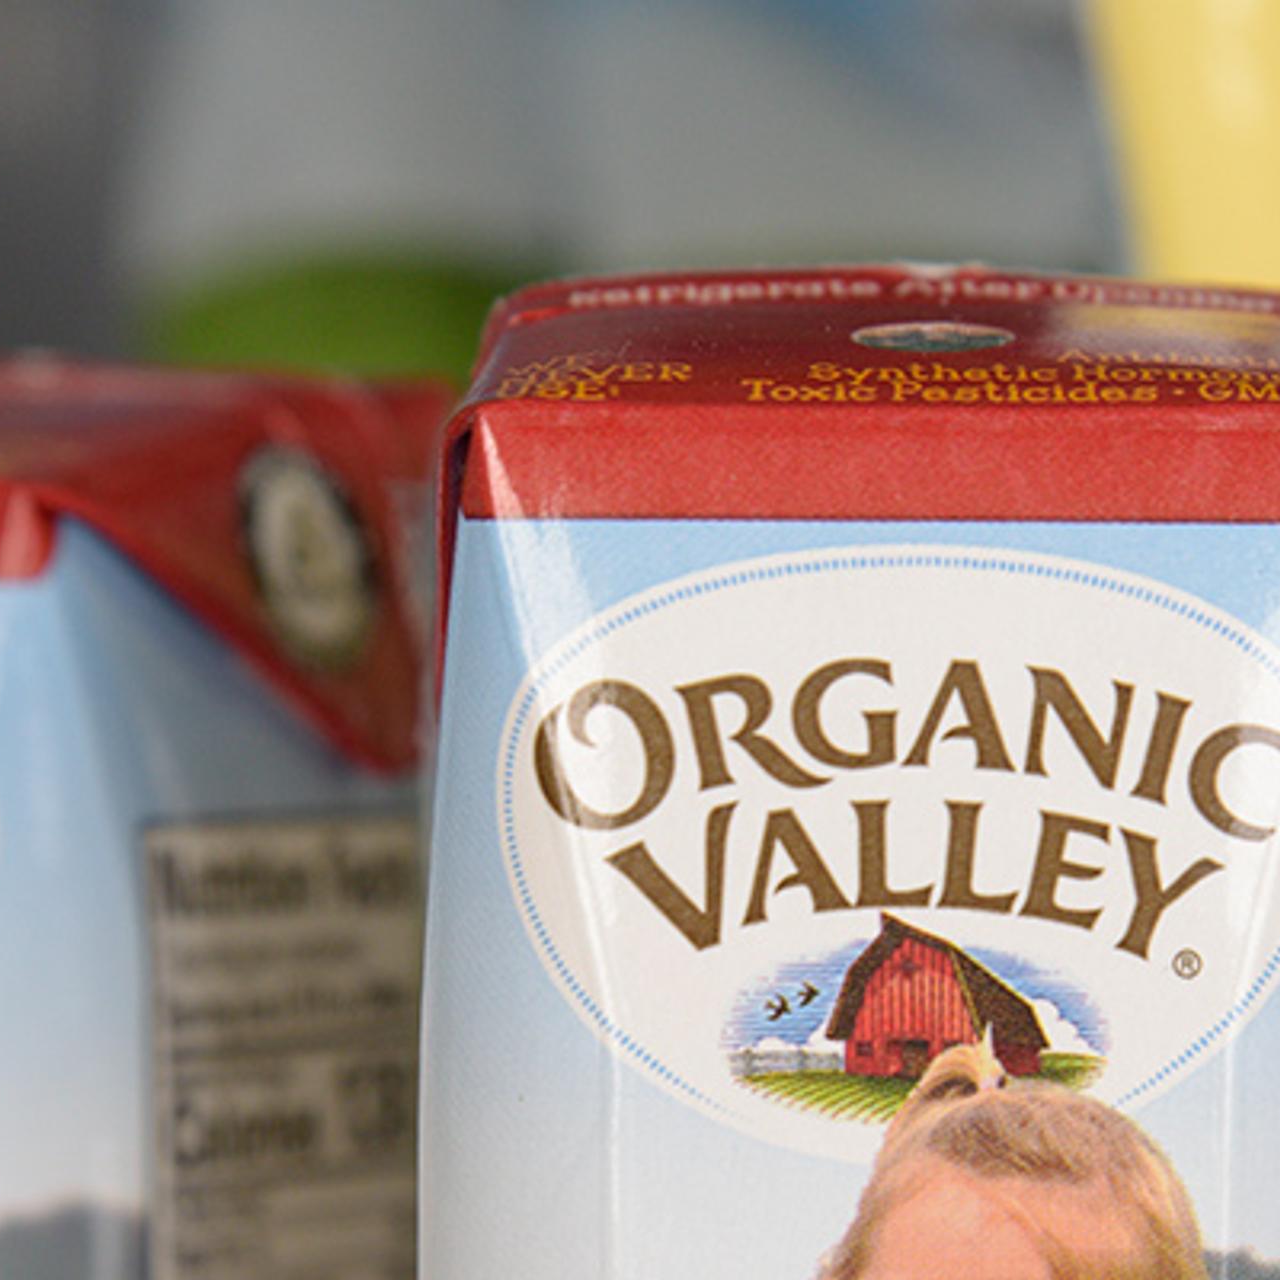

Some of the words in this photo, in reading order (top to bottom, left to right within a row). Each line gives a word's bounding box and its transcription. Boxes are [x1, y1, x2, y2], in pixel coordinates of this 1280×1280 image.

[807, 361, 1058, 384] Synthetic
[741, 377, 877, 401] Toxic
[892, 379, 1158, 401] Pesticides
[604, 798, 1226, 961] VALLEY
